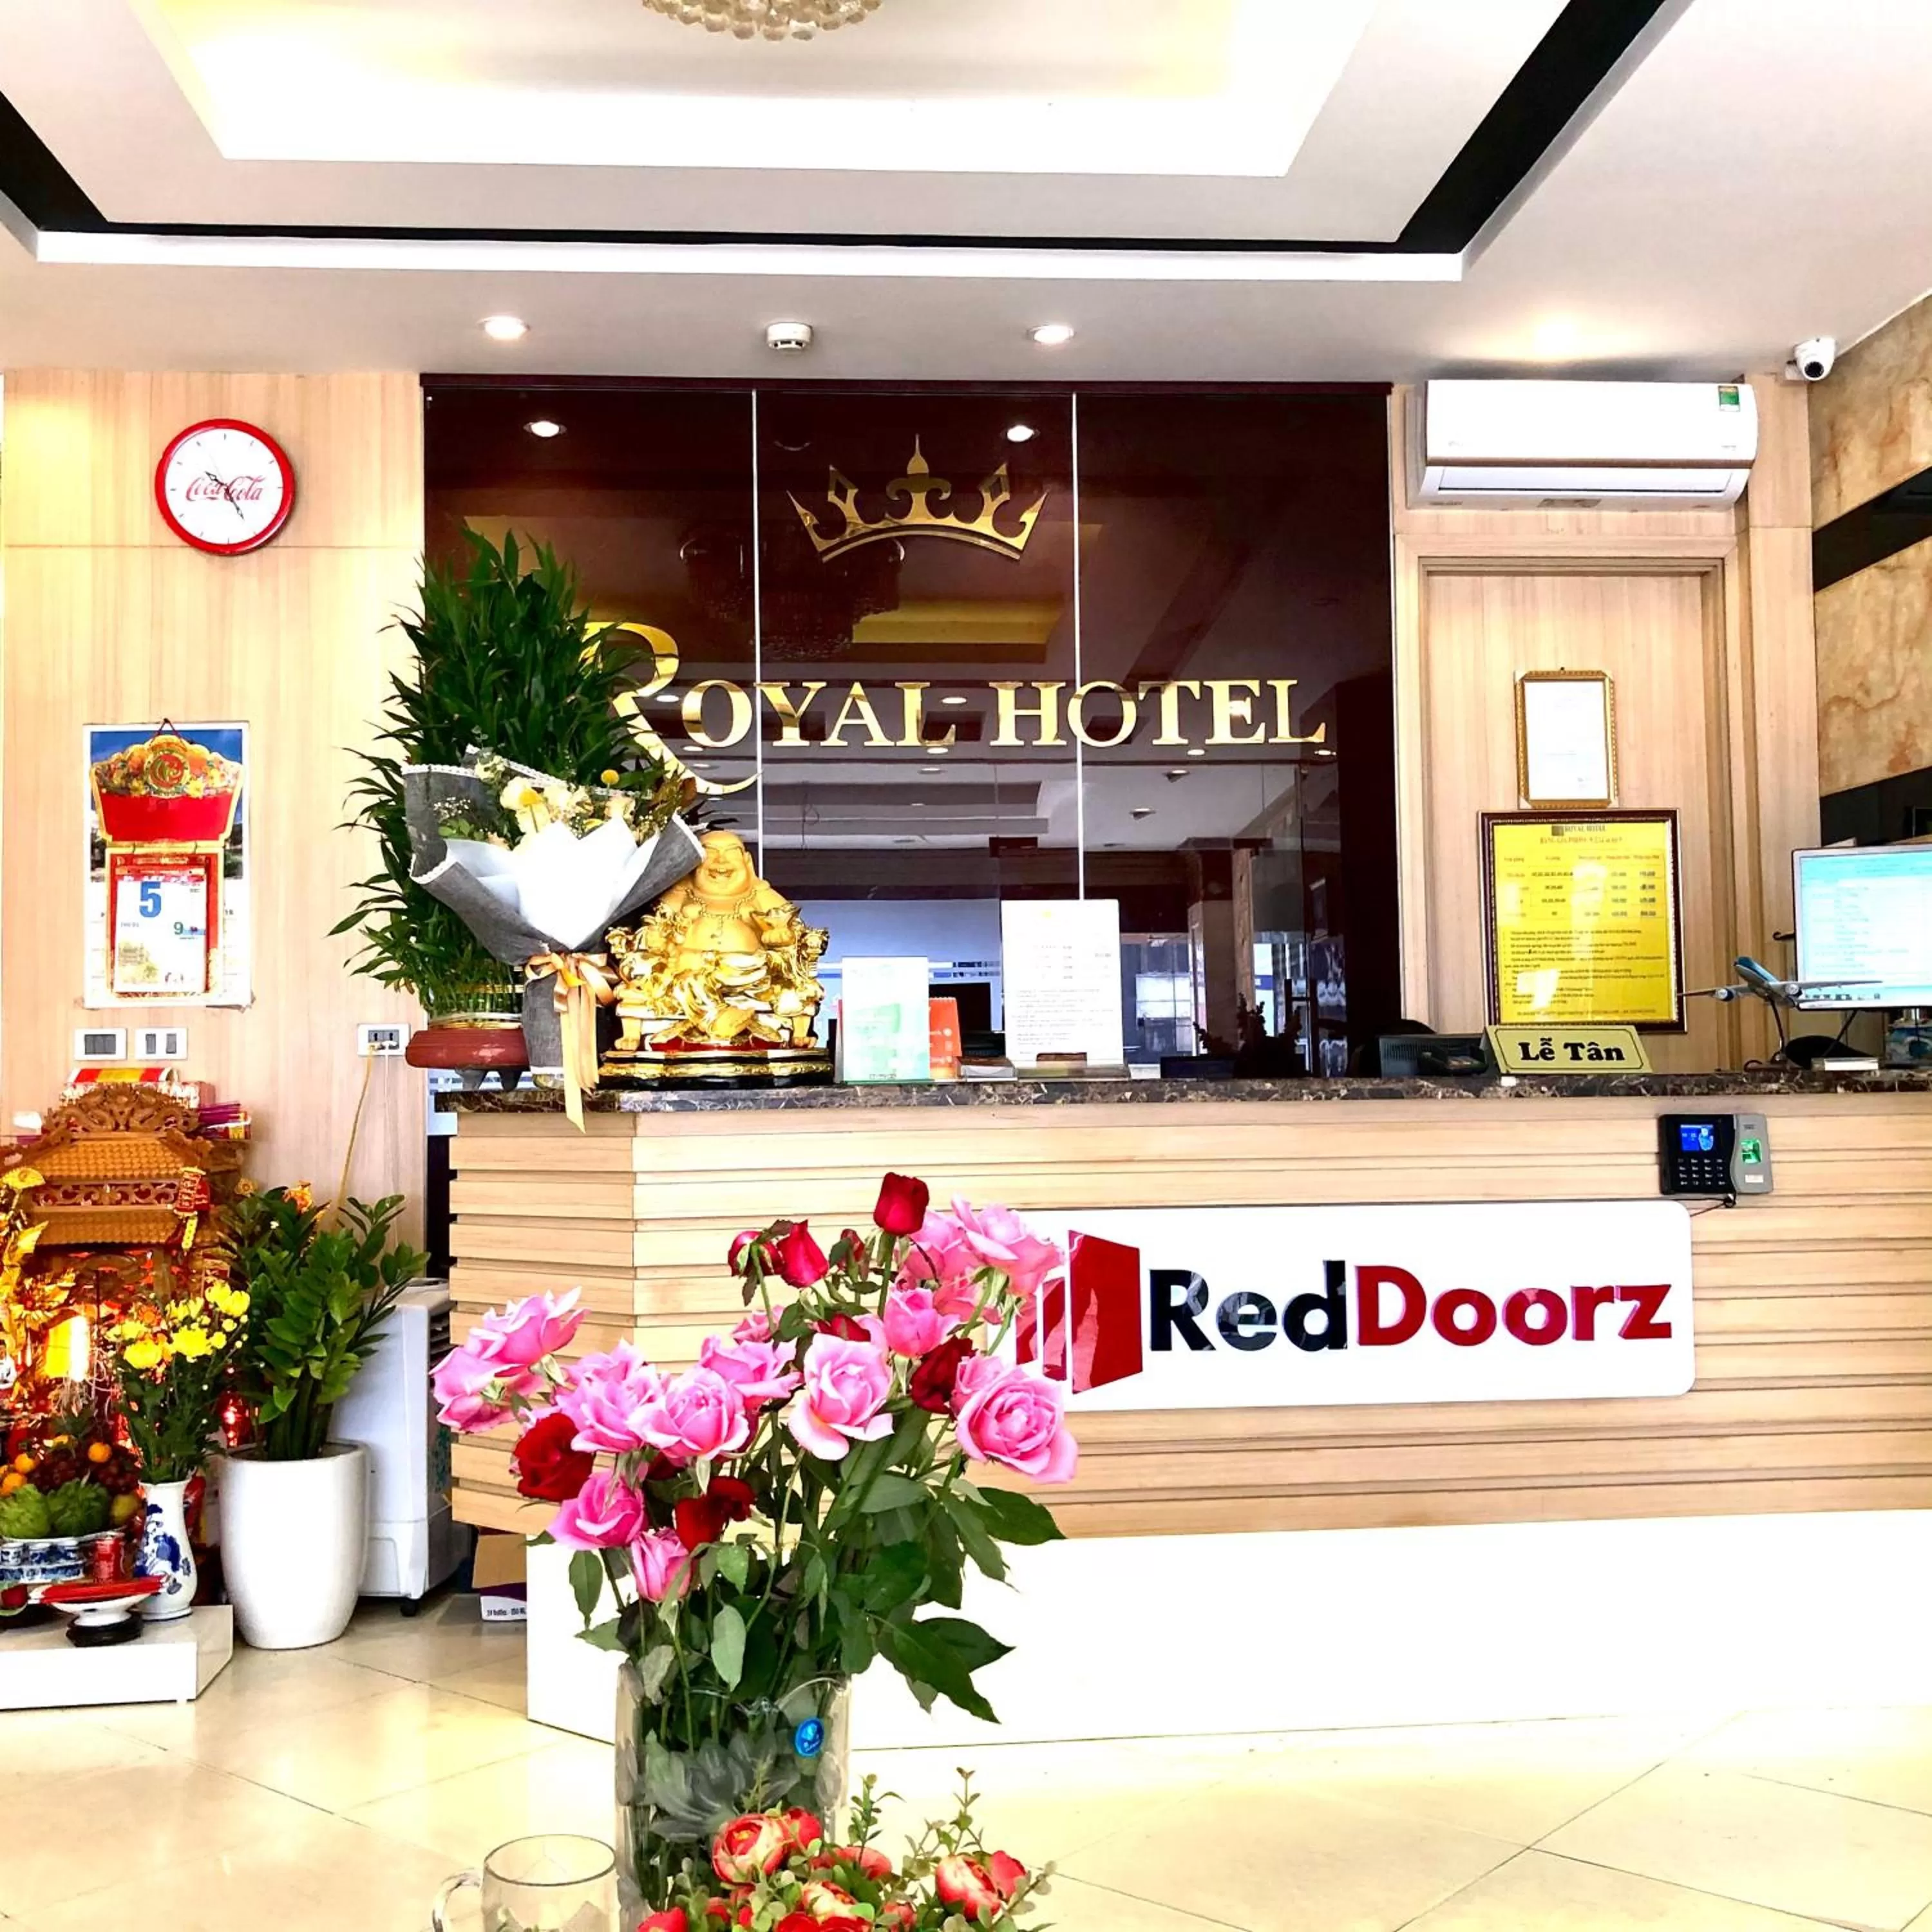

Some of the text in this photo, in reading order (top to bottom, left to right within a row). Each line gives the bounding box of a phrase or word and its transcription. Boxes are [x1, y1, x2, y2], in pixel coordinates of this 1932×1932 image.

[578, 621, 1326, 795] ROYAL HOTEL
[139, 881, 161, 918] 5
[173, 922, 184, 936] 9
[1518, 1037, 1625, 1061] Lễ Tân
[1149, 1260, 1672, 1352] RedDoorz
